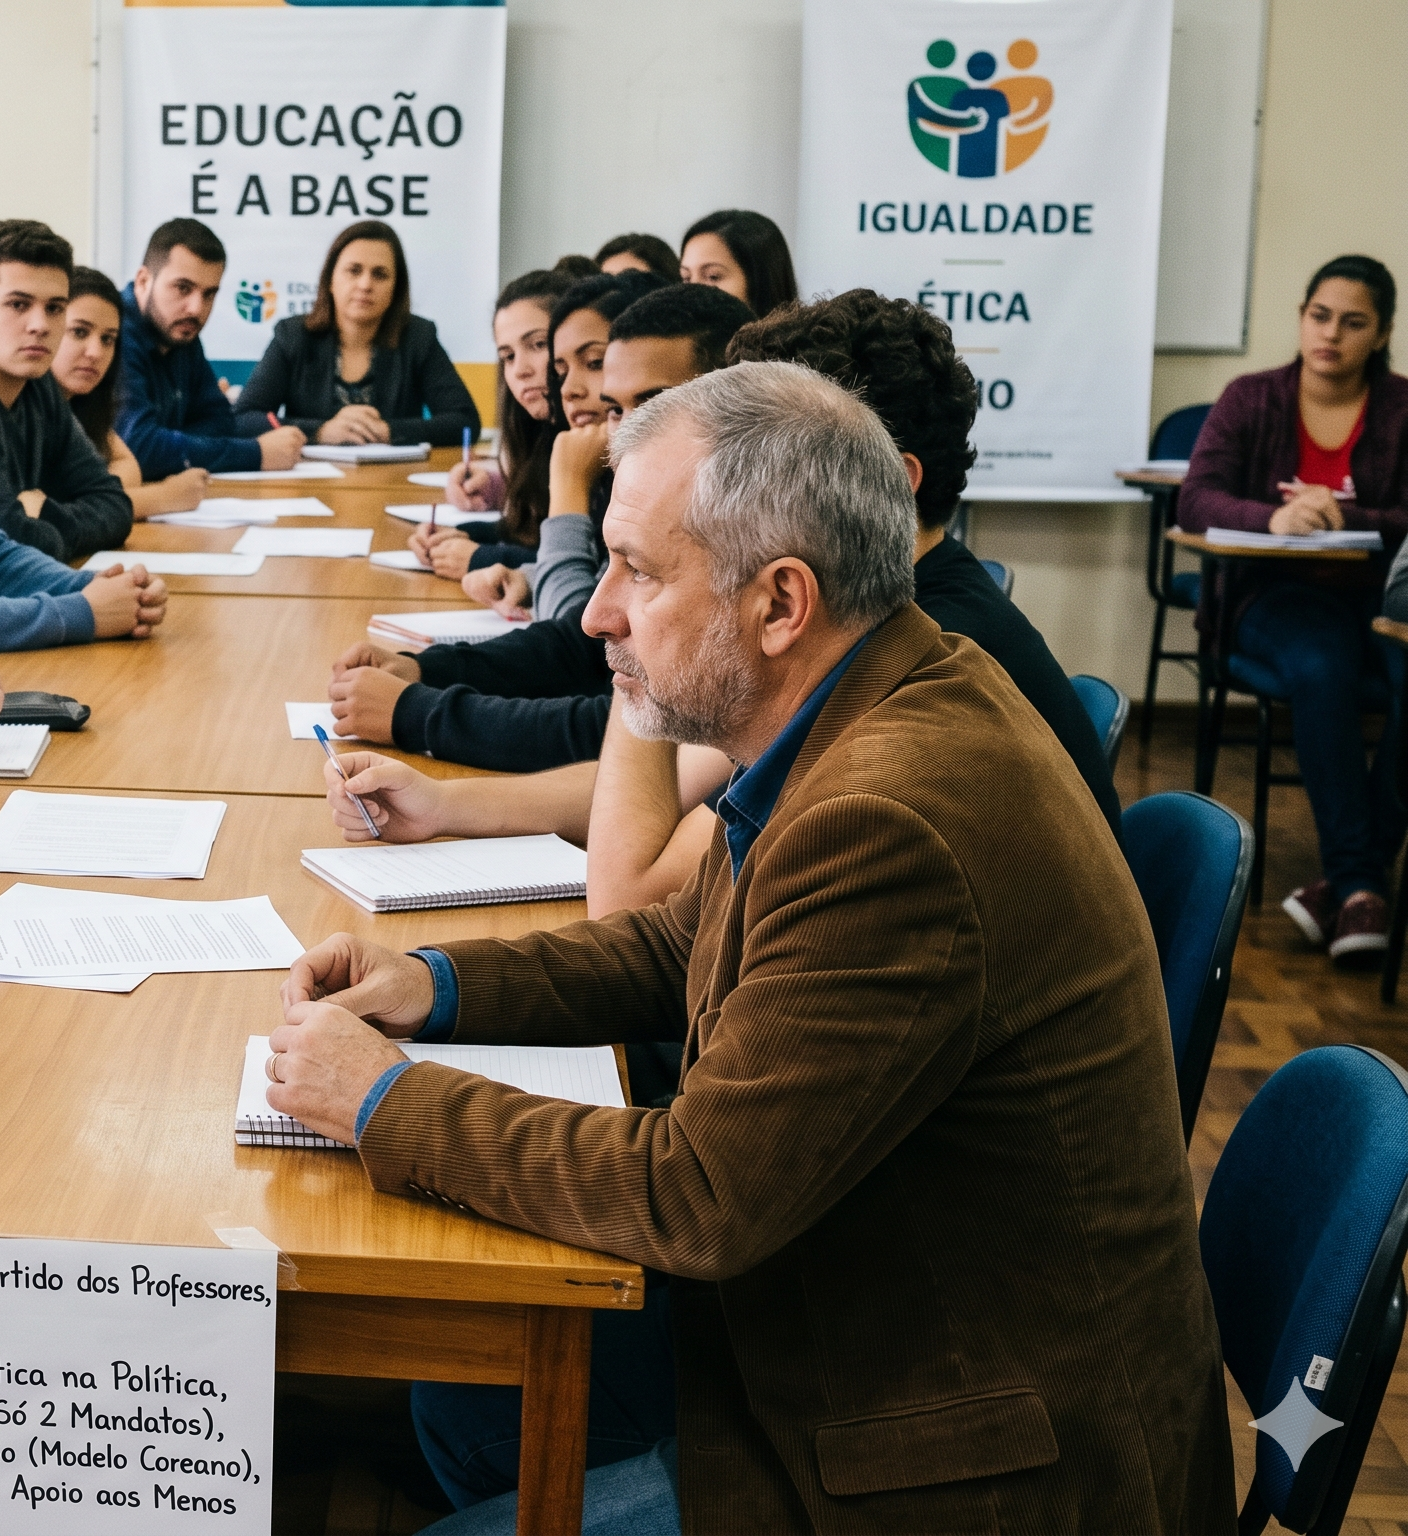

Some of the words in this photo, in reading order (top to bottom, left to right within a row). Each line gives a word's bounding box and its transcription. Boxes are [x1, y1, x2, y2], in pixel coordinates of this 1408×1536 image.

[163, 92, 462, 160] EDUCAÇÃO
[193, 161, 217, 214] É
[237, 175, 269, 215] A
[292, 175, 428, 216] BASE
[860, 203, 1092, 234] IGUALDADE
[77, 1265, 119, 1294] dos
[131, 1265, 271, 1307] Professores,
[62, 1372, 97, 1389] na
[111, 1361, 226, 1402] Política,
[40, 1401, 56, 1426] 2
[72, 1402, 223, 1442] Mandatos),
[29, 1436, 127, 1469] (Modelo
[141, 1445, 260, 1484] Coreano),
[11, 1474, 82, 1509] Apoio
[97, 1490, 140, 1507] aos
[155, 1484, 236, 1514] Menos
